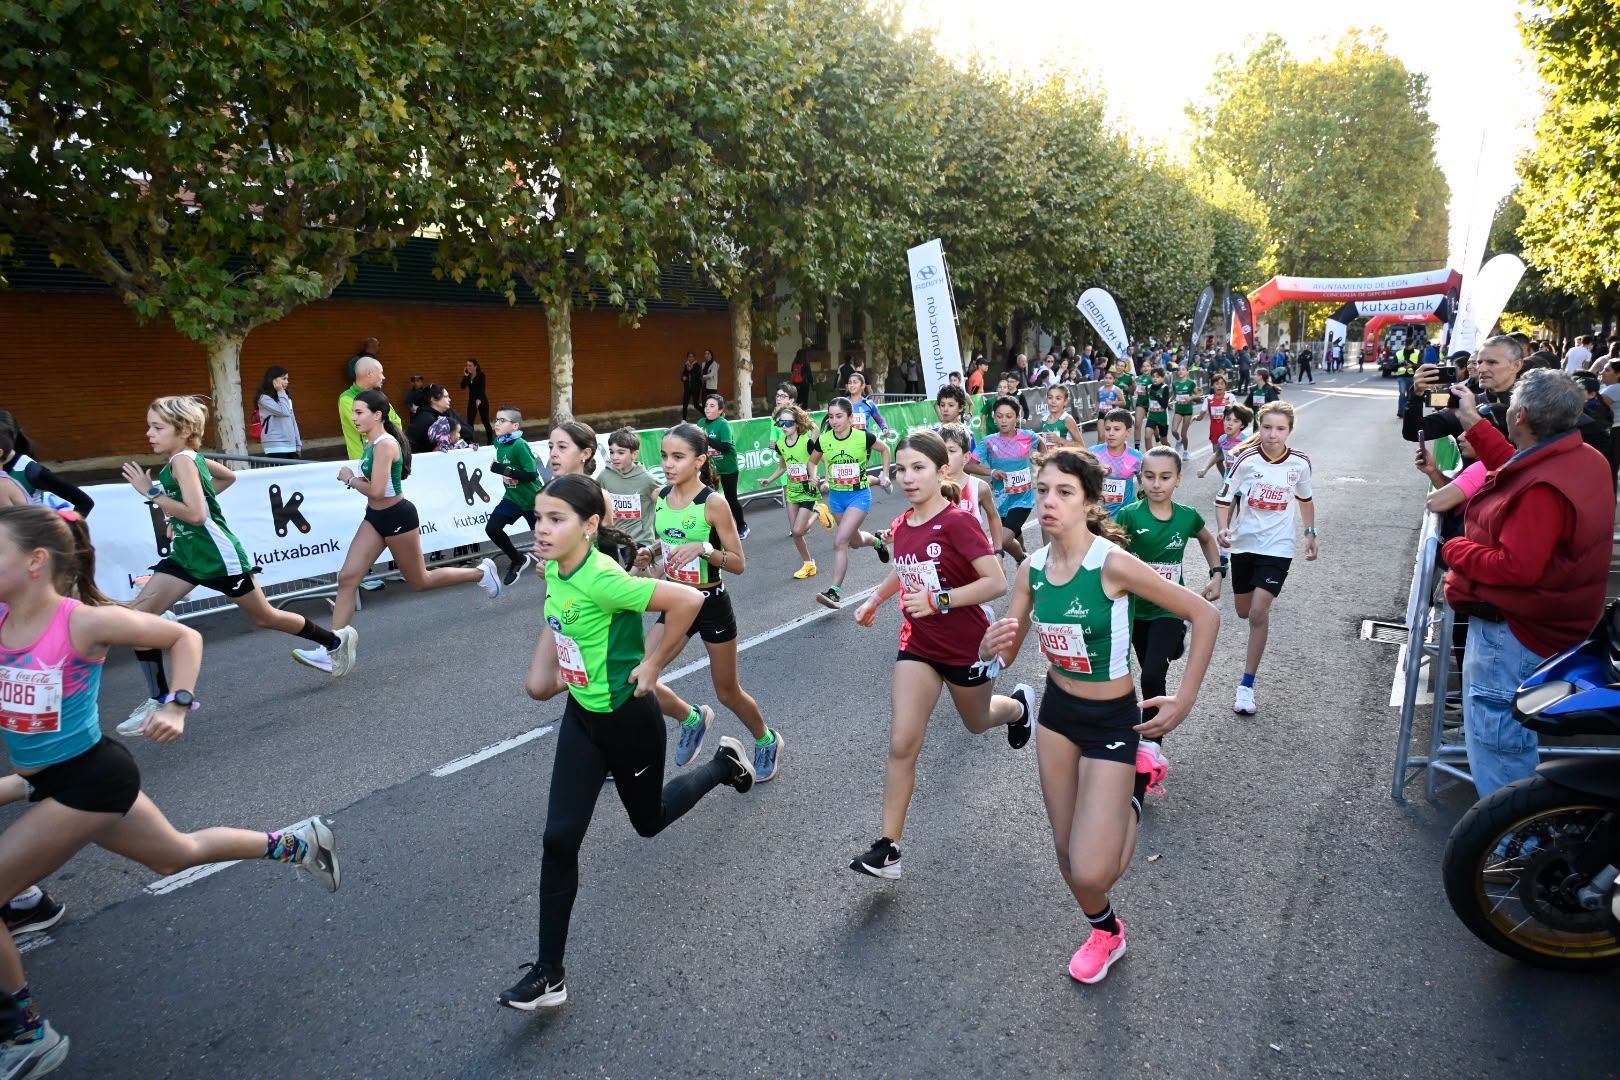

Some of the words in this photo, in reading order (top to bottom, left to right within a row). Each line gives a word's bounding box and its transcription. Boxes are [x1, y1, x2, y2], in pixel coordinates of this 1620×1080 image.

[1313, 282, 1373, 290] AYUNTAMIENTO
[1375, 281, 1386, 289] DE
[1361, 300, 1434, 312] kutxabank
[1260, 488, 1283, 501] 2065
[253, 538, 341, 566] kutxabank
[929, 545, 939, 556] 13
[0, 682, 36, 706] 086
